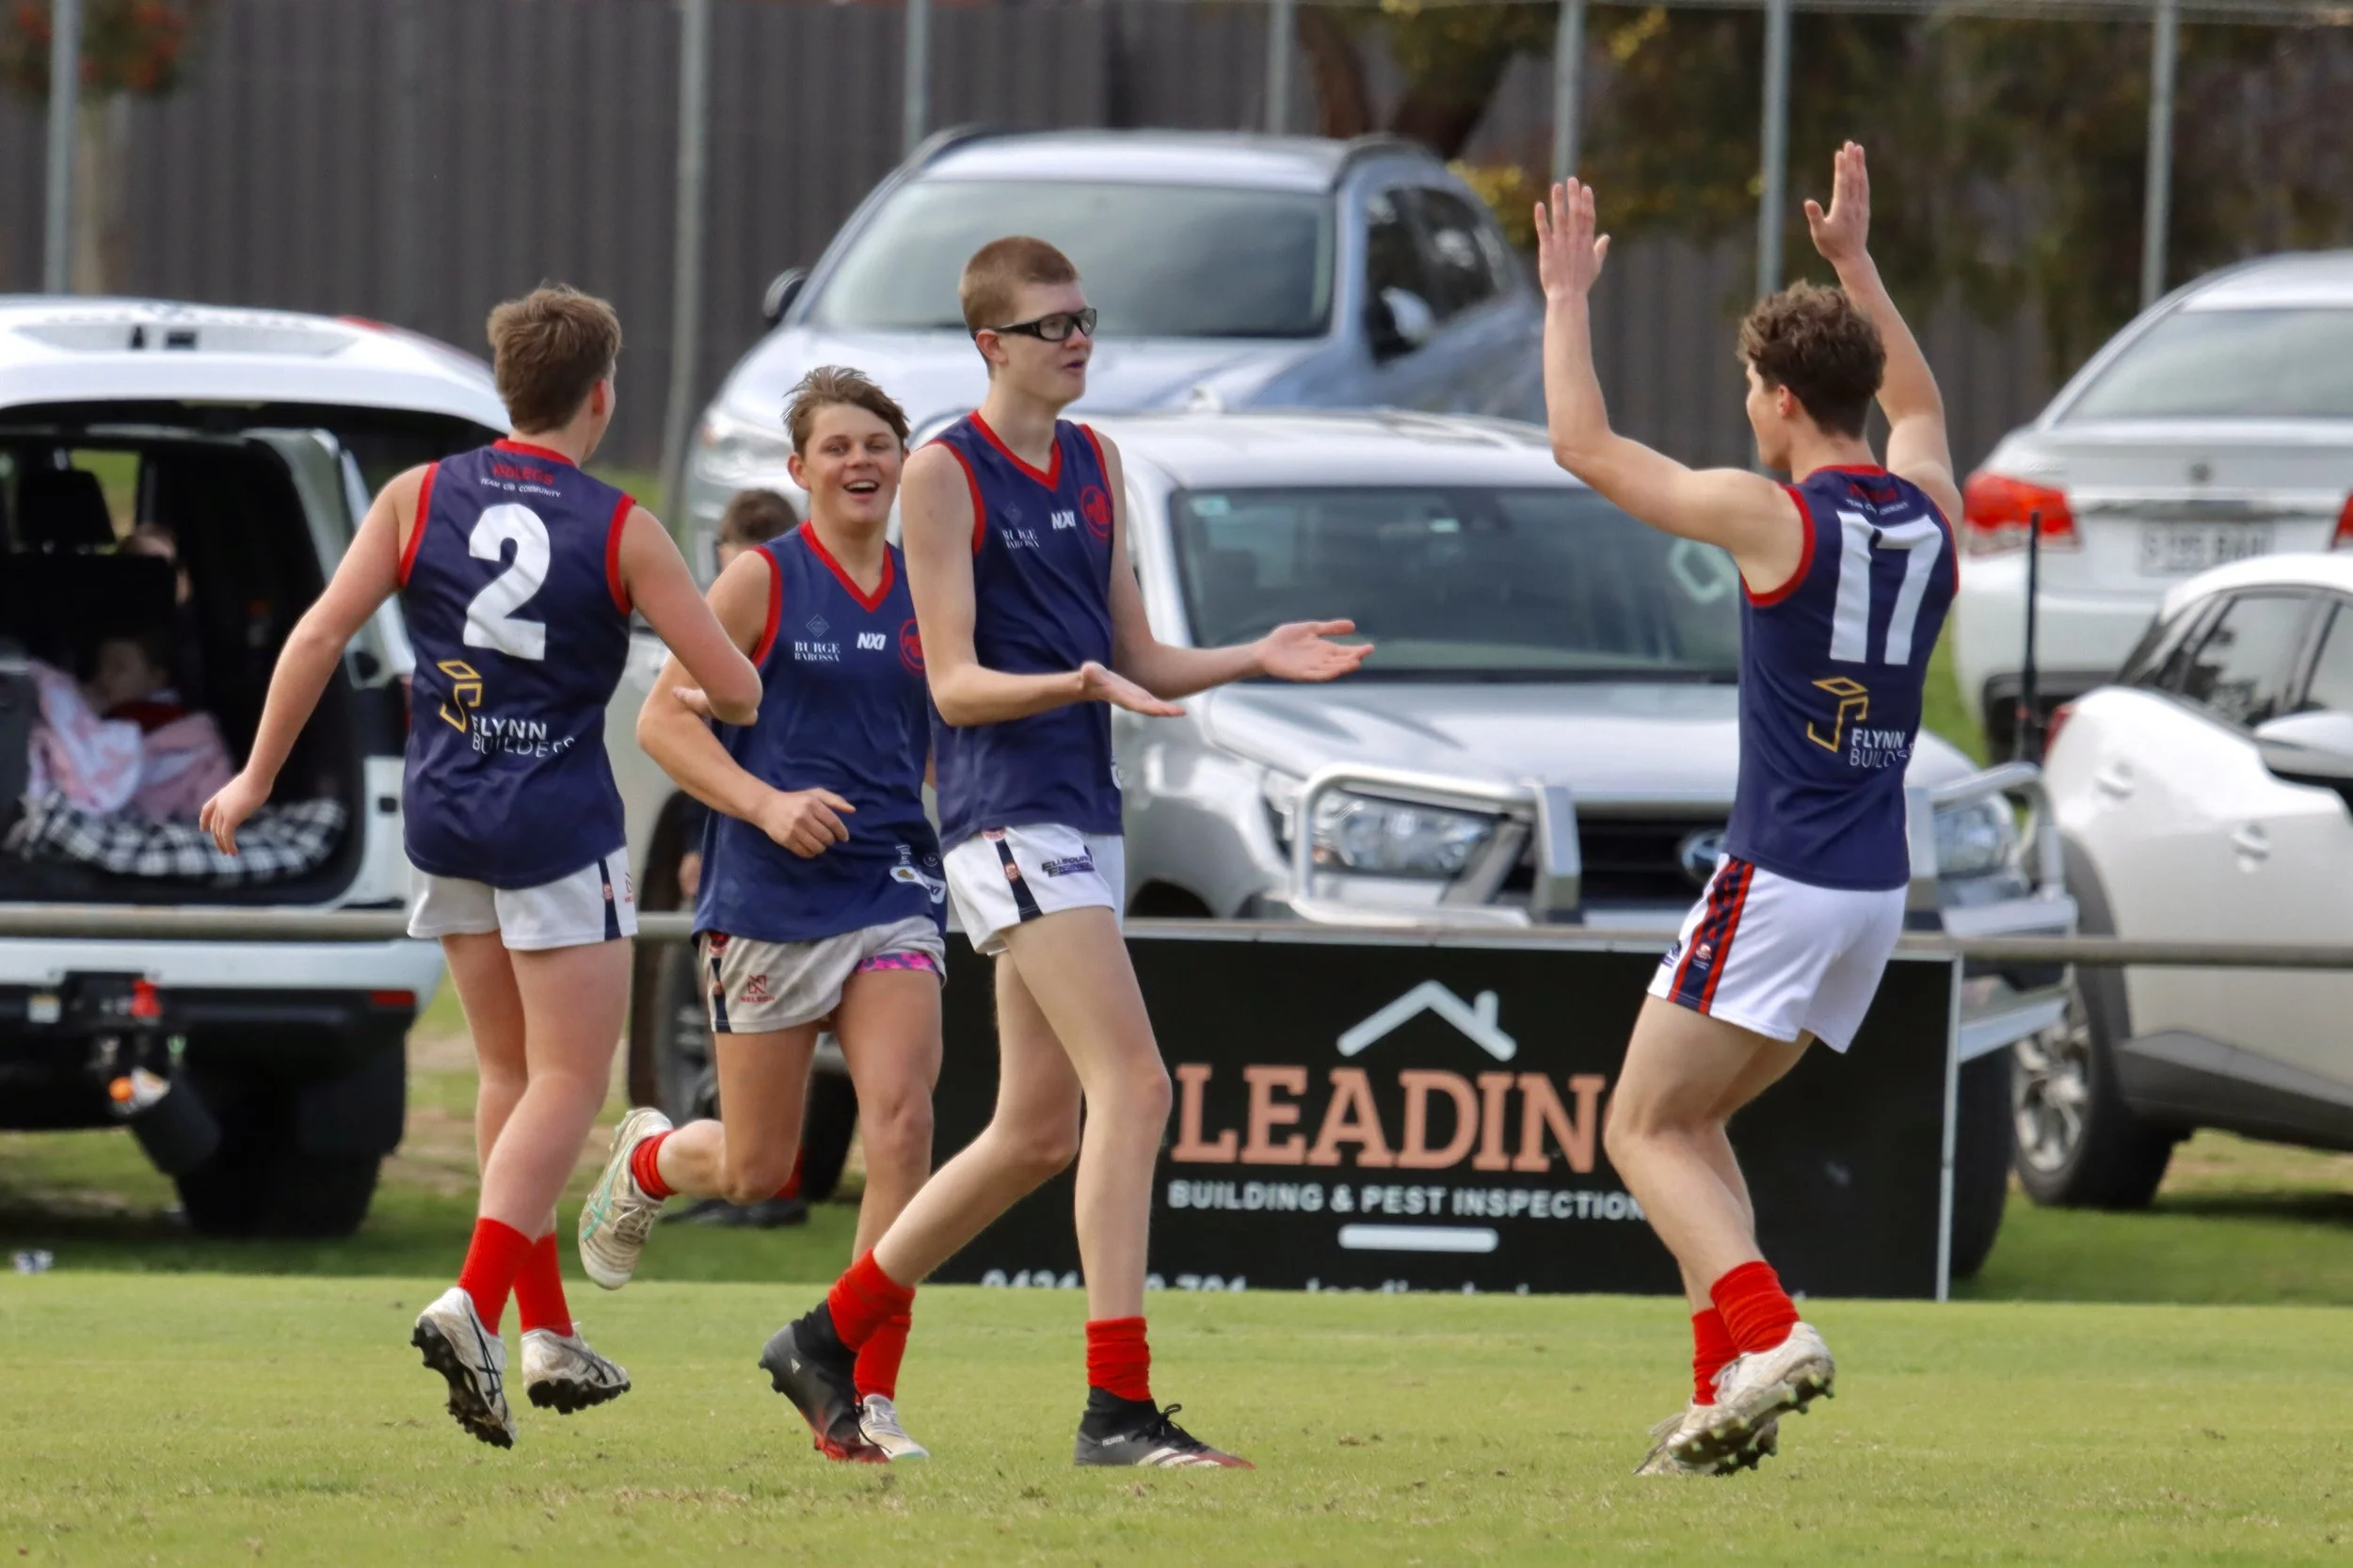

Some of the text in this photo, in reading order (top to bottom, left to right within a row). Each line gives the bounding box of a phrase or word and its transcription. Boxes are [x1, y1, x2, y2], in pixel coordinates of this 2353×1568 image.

[519, 485, 561, 498] COMMUNITY
[463, 503, 551, 661] 2
[1830, 511, 1943, 665] 17
[794, 641, 840, 654] BURGE
[794, 652, 840, 662] BAROSSA
[471, 715, 547, 741] FLYNN
[1851, 728, 1906, 748] FLYNN
[1171, 1064, 1615, 1173] LEADIN
[1167, 1179, 1324, 1212] BUILDING
[1330, 1183, 1354, 1214] &
[1360, 1184, 1447, 1215] PEST
